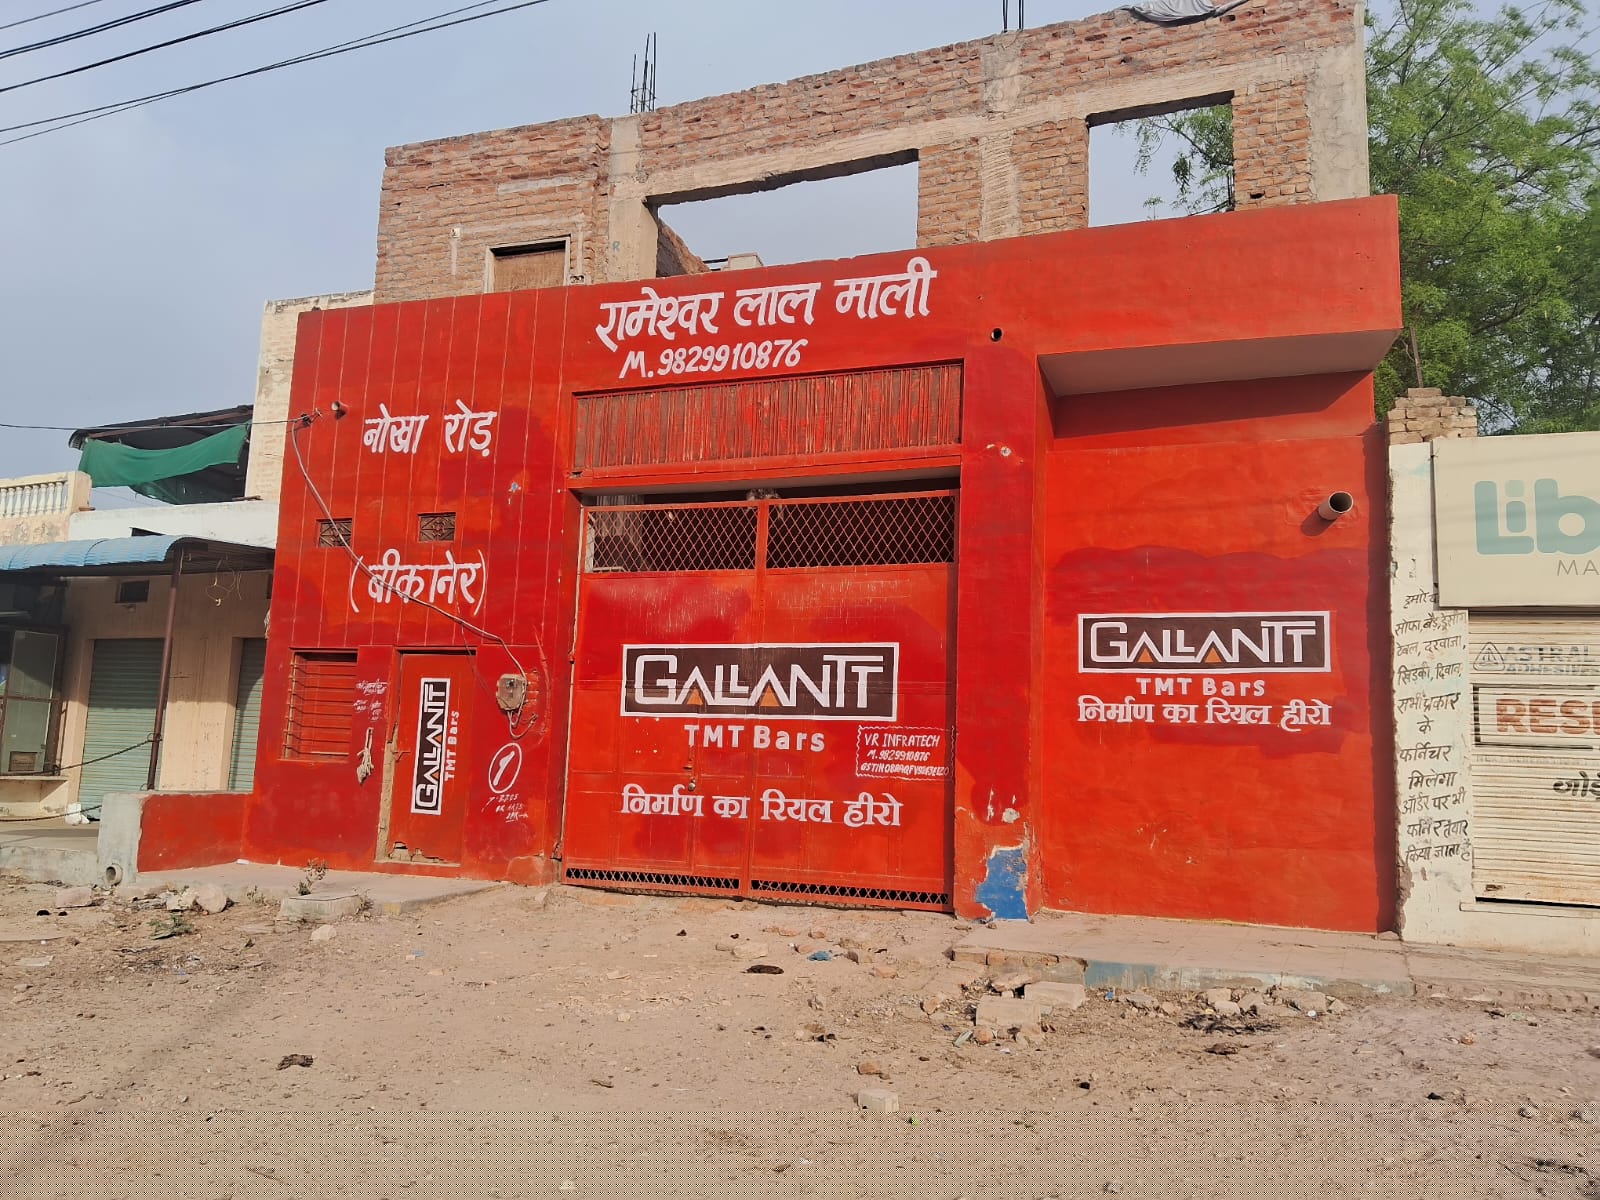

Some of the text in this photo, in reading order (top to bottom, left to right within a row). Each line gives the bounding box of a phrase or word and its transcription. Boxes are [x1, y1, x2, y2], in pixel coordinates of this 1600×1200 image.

[595, 256, 938, 353] रामेश्वर लाल माली
[363, 399, 497, 457] नोखा रोड़
[351, 548, 486, 616] (बीकानेर)
[1090, 621, 1316, 663] GALLANTT
[635, 654, 884, 709] GALLANTT
[1136, 677, 1265, 696] TMT Bars
[1077, 694, 1332, 732] निर्माण का रियल हीरो
[1416, 715, 1434, 734] के
[415, 683, 446, 808] GALLANTT
[684, 725, 825, 752] TMT Bars
[864, 733, 940, 747] VR INFRATECH
[444, 749, 457, 782] TMT
[620, 783, 904, 828] निर्माण का रियल हीरो
[1432, 795, 1451, 810] पर
